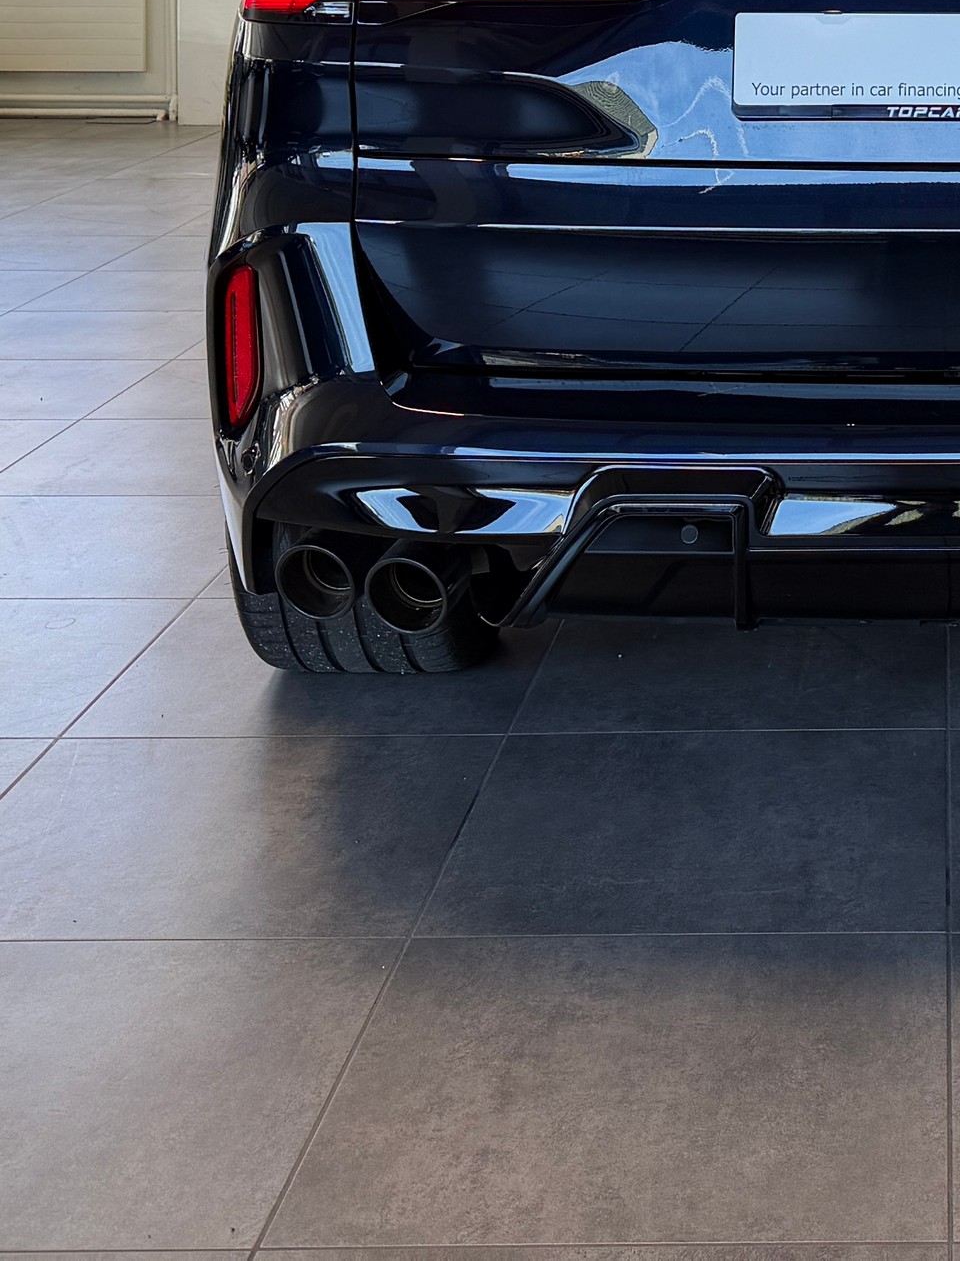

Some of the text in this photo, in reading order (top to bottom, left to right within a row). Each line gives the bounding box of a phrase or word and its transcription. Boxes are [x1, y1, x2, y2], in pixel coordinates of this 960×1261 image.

[752, 82, 785, 96] Your
[791, 83, 845, 99] partner
[851, 82, 864, 96] in
[870, 85, 892, 96] car
